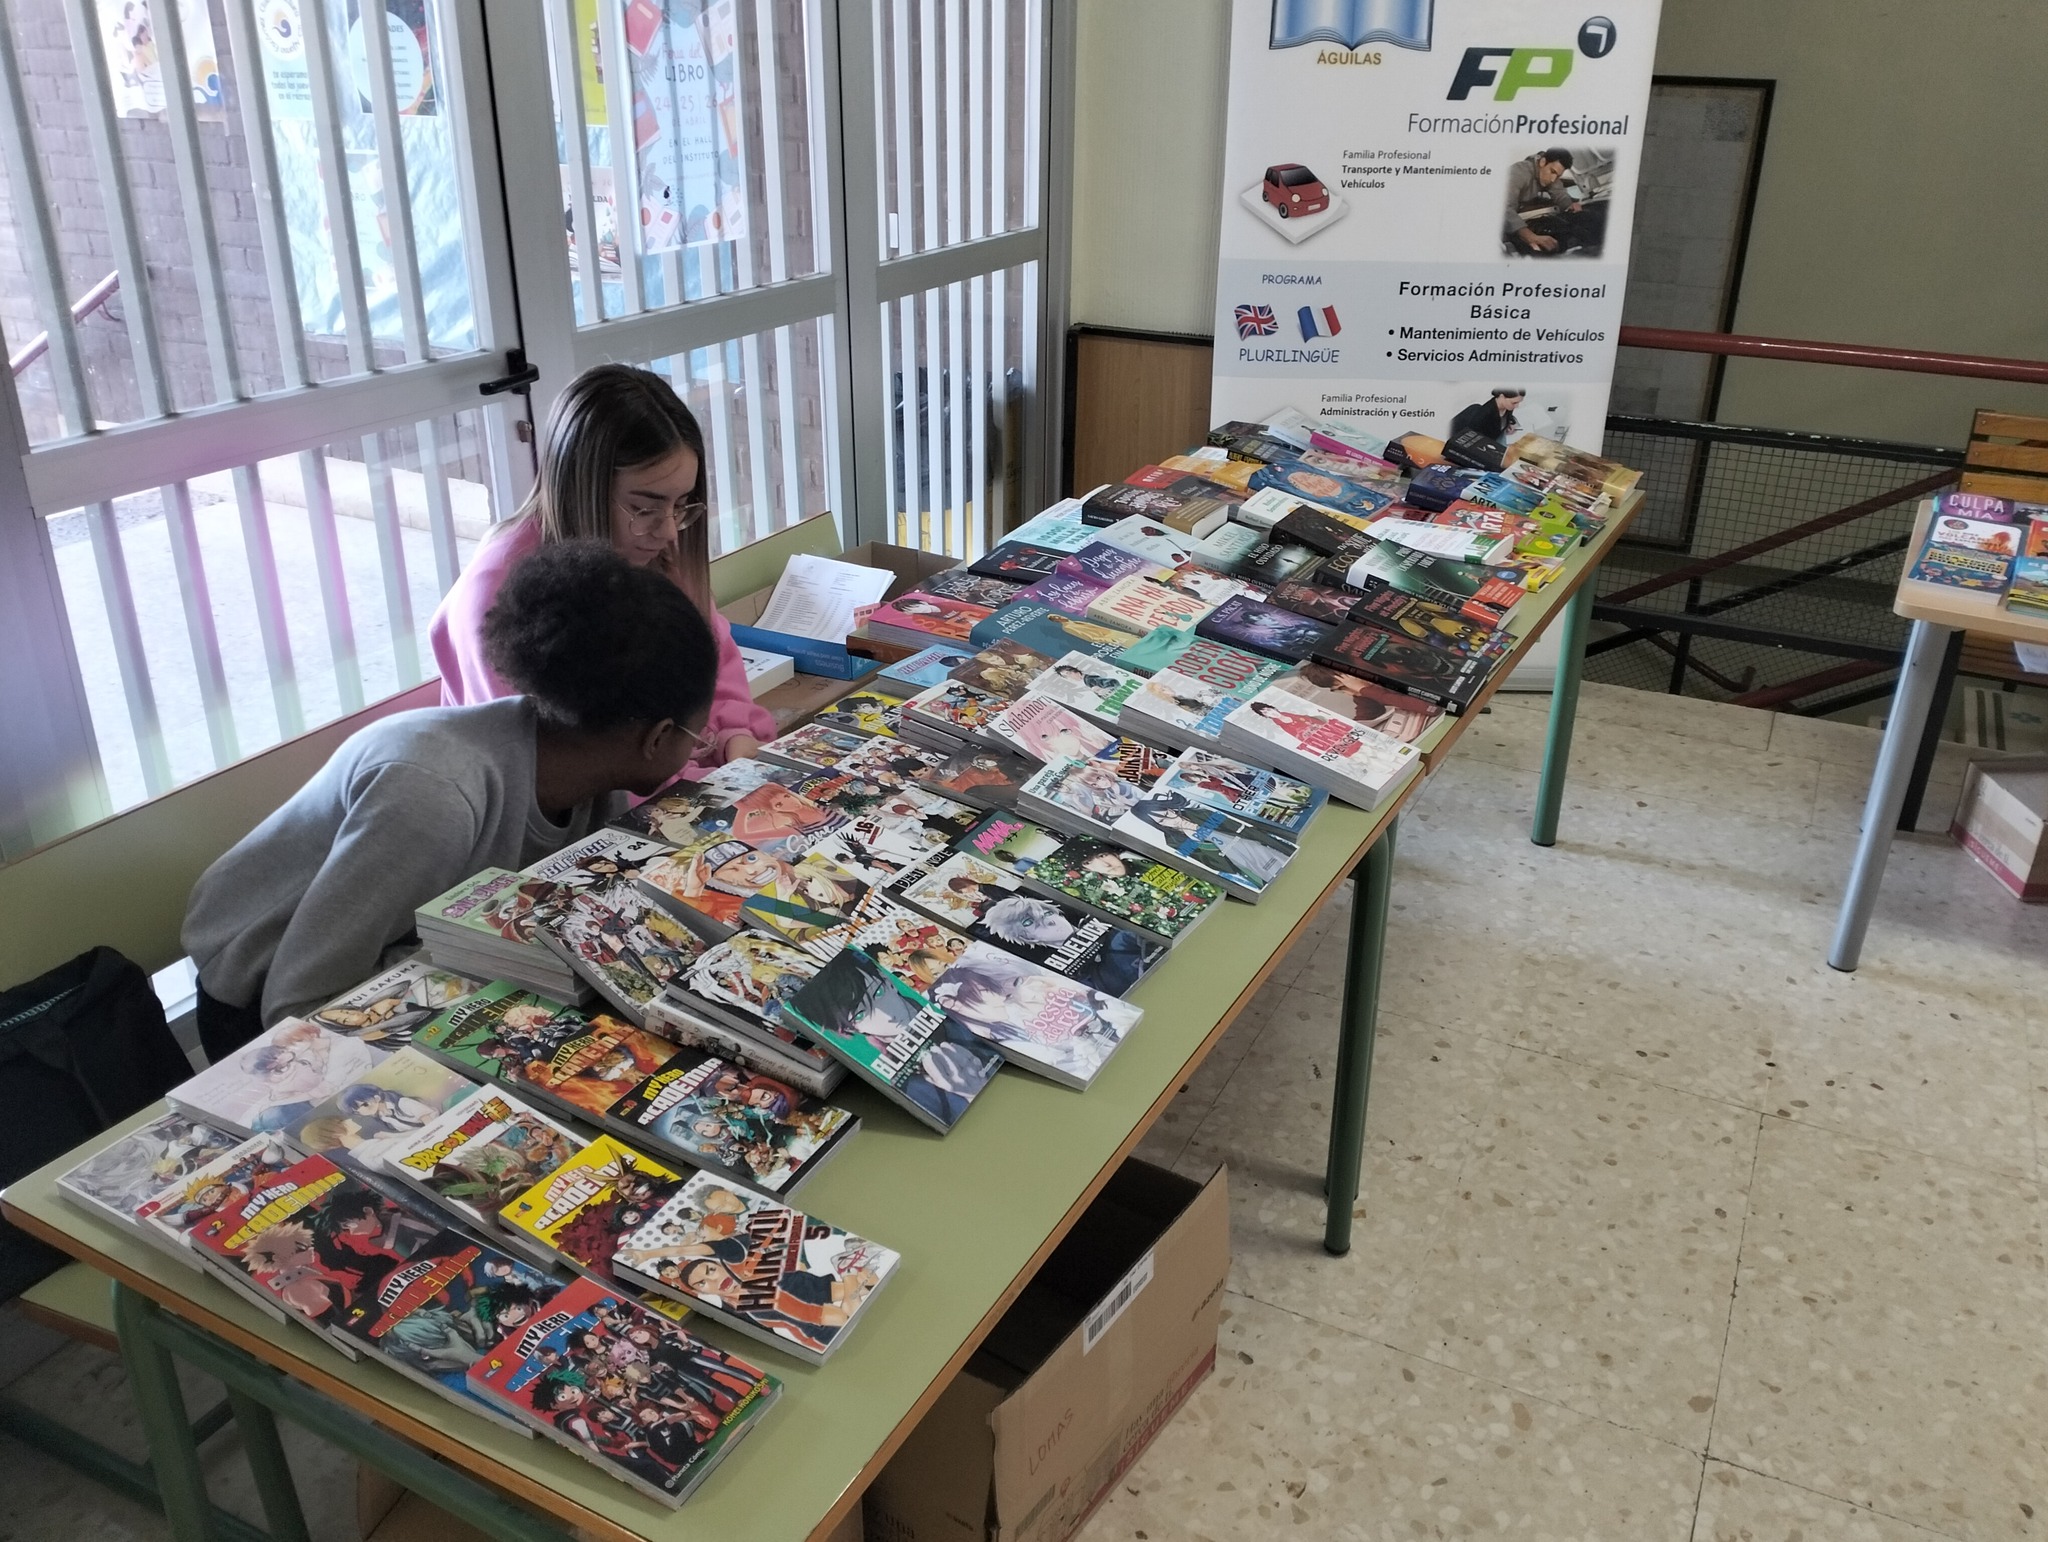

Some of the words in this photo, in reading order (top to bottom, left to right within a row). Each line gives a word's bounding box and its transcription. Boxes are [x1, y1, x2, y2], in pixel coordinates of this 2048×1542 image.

[1316, 51, 1382, 66] ÁGUILAS
[664, 63, 704, 83] LIBRO
[1446, 47, 1574, 102] FP
[680, 95, 694, 111] 25
[682, 136, 691, 147] EL
[694, 134, 713, 145] HALL
[1343, 149, 1376, 160] Familia
[1378, 150, 1431, 160] Profesional
[1342, 164, 1393, 178] Transporte
[1395, 168, 1401, 177] y
[1402, 164, 1478, 176] Mantenimiento
[1480, 166, 1492, 176] de
[1340, 178, 1386, 190] Vehículos
[1262, 274, 1323, 286] PROGRAMA
[1399, 281, 1496, 299] Formación
[1502, 282, 1607, 299] Profesional
[1470, 304, 1531, 320] Básica
[1399, 326, 1509, 341] Mantenimiento
[1513, 328, 1531, 341] de
[1536, 328, 1605, 342] Vehículos
[1239, 347, 1340, 364] PLURILINGÜE
[1397, 348, 1465, 362] Servicios
[1468, 349, 1584, 364] Administrativos
[1321, 393, 1353, 404] Familia
[1355, 394, 1407, 405] Profesional
[1320, 407, 1389, 420] Administración
[1391, 411, 1398, 420] y
[1400, 407, 1435, 420] Gestión
[1470, 495, 1498, 509] ARTA
[1949, 494, 2005, 513] CULPA
[1957, 508, 1994, 520] MIA
[1213, 531, 1239, 549] MIKEL
[1247, 548, 1259, 559] EL
[1110, 594, 1149, 622] ANA
[1133, 583, 1173, 604] HA
[997, 605, 1034, 628] ARTURO
[1167, 639, 1227, 678] ROBIN
[1198, 649, 1267, 690] COOK
[1000, 694, 1053, 738] Shikimori
[1176, 718, 1190, 729] 2
[1297, 718, 1354, 756] TOKYO
[1321, 727, 1366, 762] REVENGERS
[1028, 783, 1040, 795] Una
[1037, 769, 1055, 788] pareja
[854, 821, 875, 834] 16
[971, 819, 1019, 855] NANA
[626, 840, 649, 852] 24
[537, 838, 613, 880] BLEACH
[925, 849, 954, 869] NOTE
[1044, 916, 1113, 972] BLUELOCK
[346, 992, 368, 1007] YUI
[371, 961, 421, 993] SAKUMA
[447, 1008, 468, 1028] MY
[464, 997, 492, 1016] HERO
[1032, 987, 1077, 1031] bestia
[1059, 999, 1096, 1037] rey
[552, 1046, 574, 1068] MY
[568, 1034, 598, 1056] HERO
[870, 1003, 947, 1080] BLUELOCK
[638, 1056, 724, 1127] ACADEMIA
[642, 1080, 664, 1102] MY
[660, 1067, 686, 1086] HERO
[399, 1129, 471, 1173] DRAGON
[458, 1108, 495, 1138] BALL
[543, 1177, 567, 1203] MY
[562, 1164, 596, 1190] HERO
[239, 1197, 267, 1221] MY
[263, 1181, 299, 1205] HERO
[211, 1219, 226, 1232] 2
[804, 1225, 832, 1241] 5
[378, 1273, 403, 1307] MY
[399, 1260, 437, 1285] HERO
[352, 1308, 366, 1319] 3
[515, 1327, 543, 1360] MY
[537, 1312, 572, 1335] HERO
[489, 1359, 503, 1370] 4
[738, 1377, 769, 1412] HORIKOSHI
[1029, 1407, 1074, 1477] LOMAS
[672, 1461, 692, 1483] Planeta
[688, 1446, 706, 1465] Cómic
